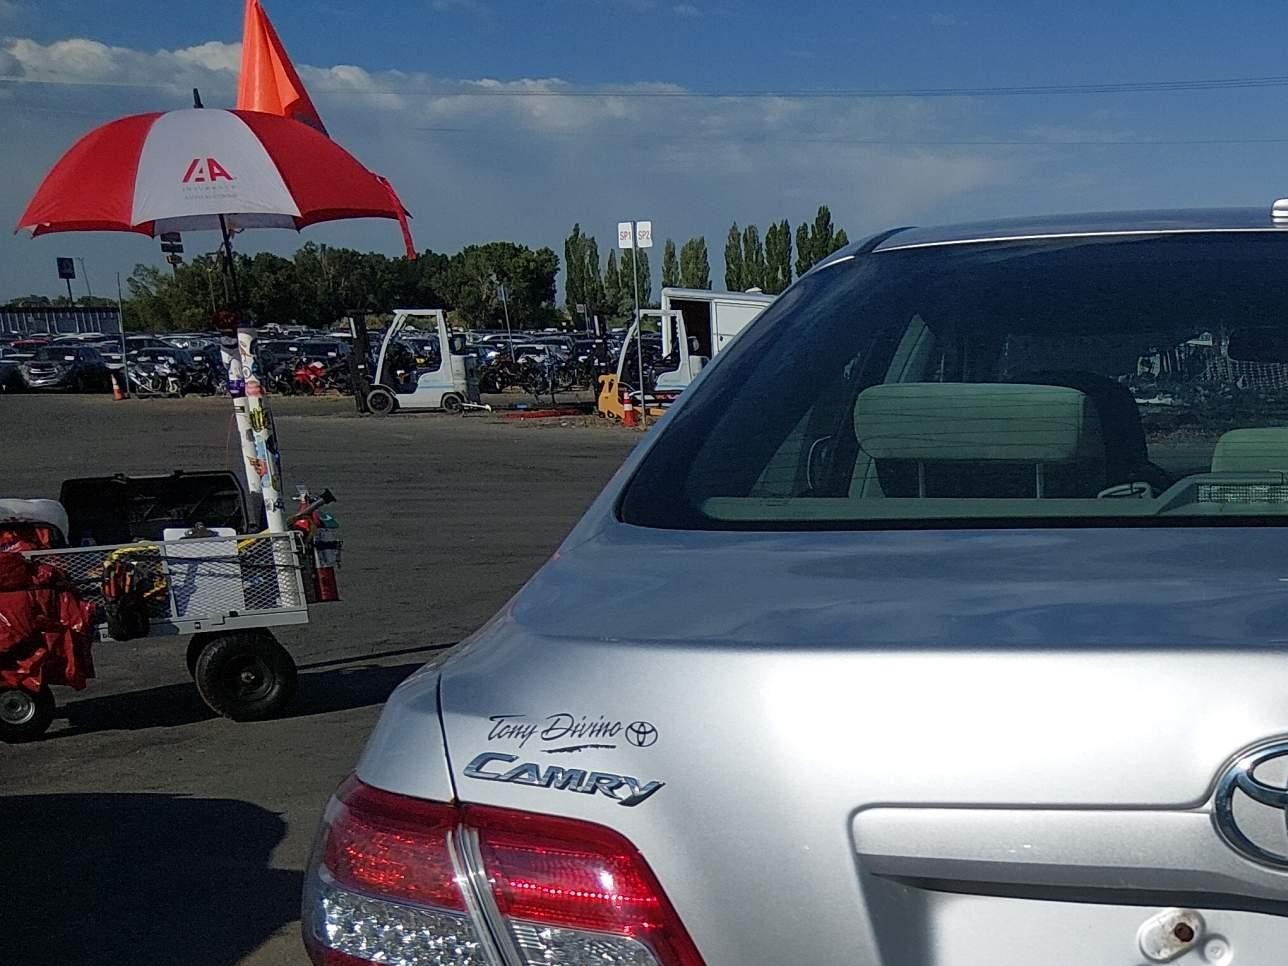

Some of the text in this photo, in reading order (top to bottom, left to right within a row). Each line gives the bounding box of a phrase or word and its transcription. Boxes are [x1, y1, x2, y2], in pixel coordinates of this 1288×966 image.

[487, 712, 623, 749] Tony Divino
[463, 752, 666, 807] CAMRY
